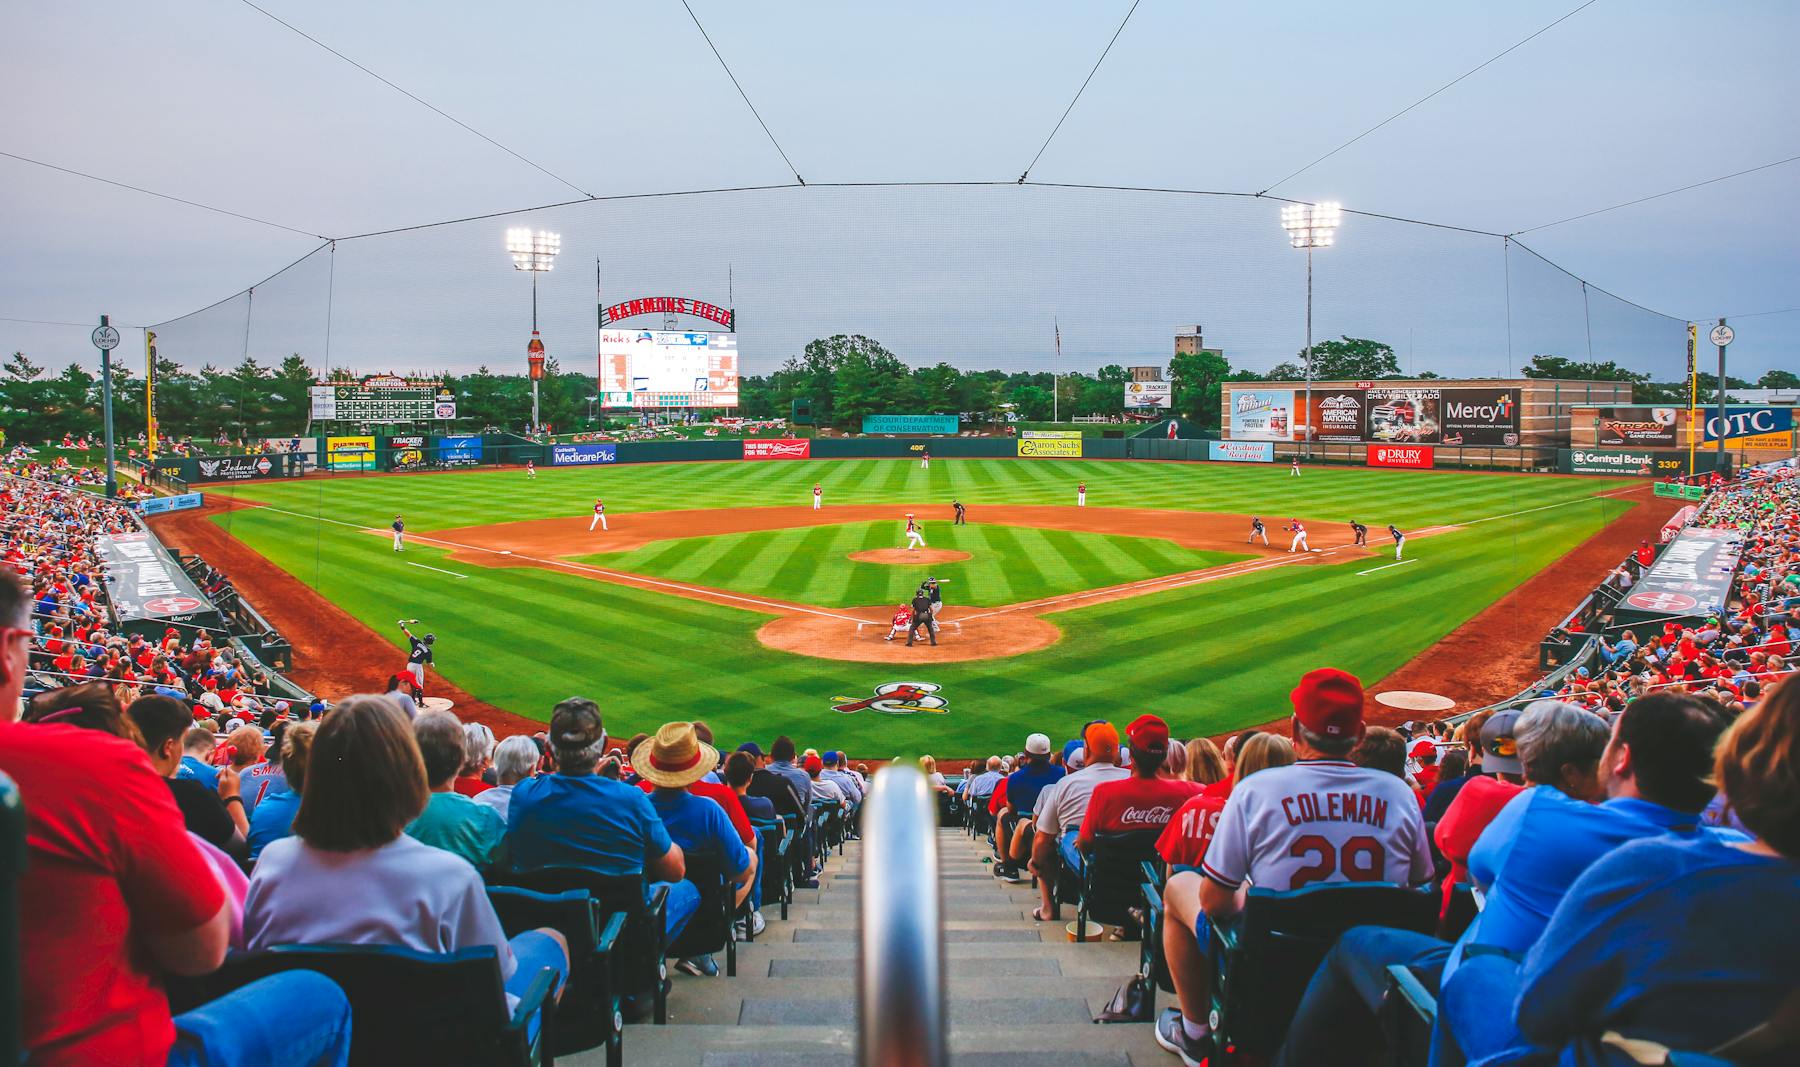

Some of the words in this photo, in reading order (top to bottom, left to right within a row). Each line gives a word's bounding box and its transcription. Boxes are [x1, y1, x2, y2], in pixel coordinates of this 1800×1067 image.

[607, 297, 686, 323] HAMMONS
[692, 300, 733, 326] FIELD
[903, 416, 955, 424] DEPARTMENT
[1446, 402, 1500, 423] Mercy
[1605, 421, 1665, 438] XTREAM
[1706, 409, 1775, 438] OTC
[1031, 441, 1055, 449] Aaron
[1057, 440, 1080, 449] Sachs
[1225, 443, 1264, 452] Cardinal
[555, 449, 615, 464] MedicarePlus
[1228, 451, 1263, 461] Roofing
[1387, 449, 1422, 459] DRURY
[1586, 453, 1623, 464] Central
[1624, 454, 1654, 465] Bank
[220, 457, 258, 472] Federal
[171, 614, 193, 622] Mercy
[1282, 792, 1388, 830] COLEMAN
[1289, 834, 1386, 890] 29
